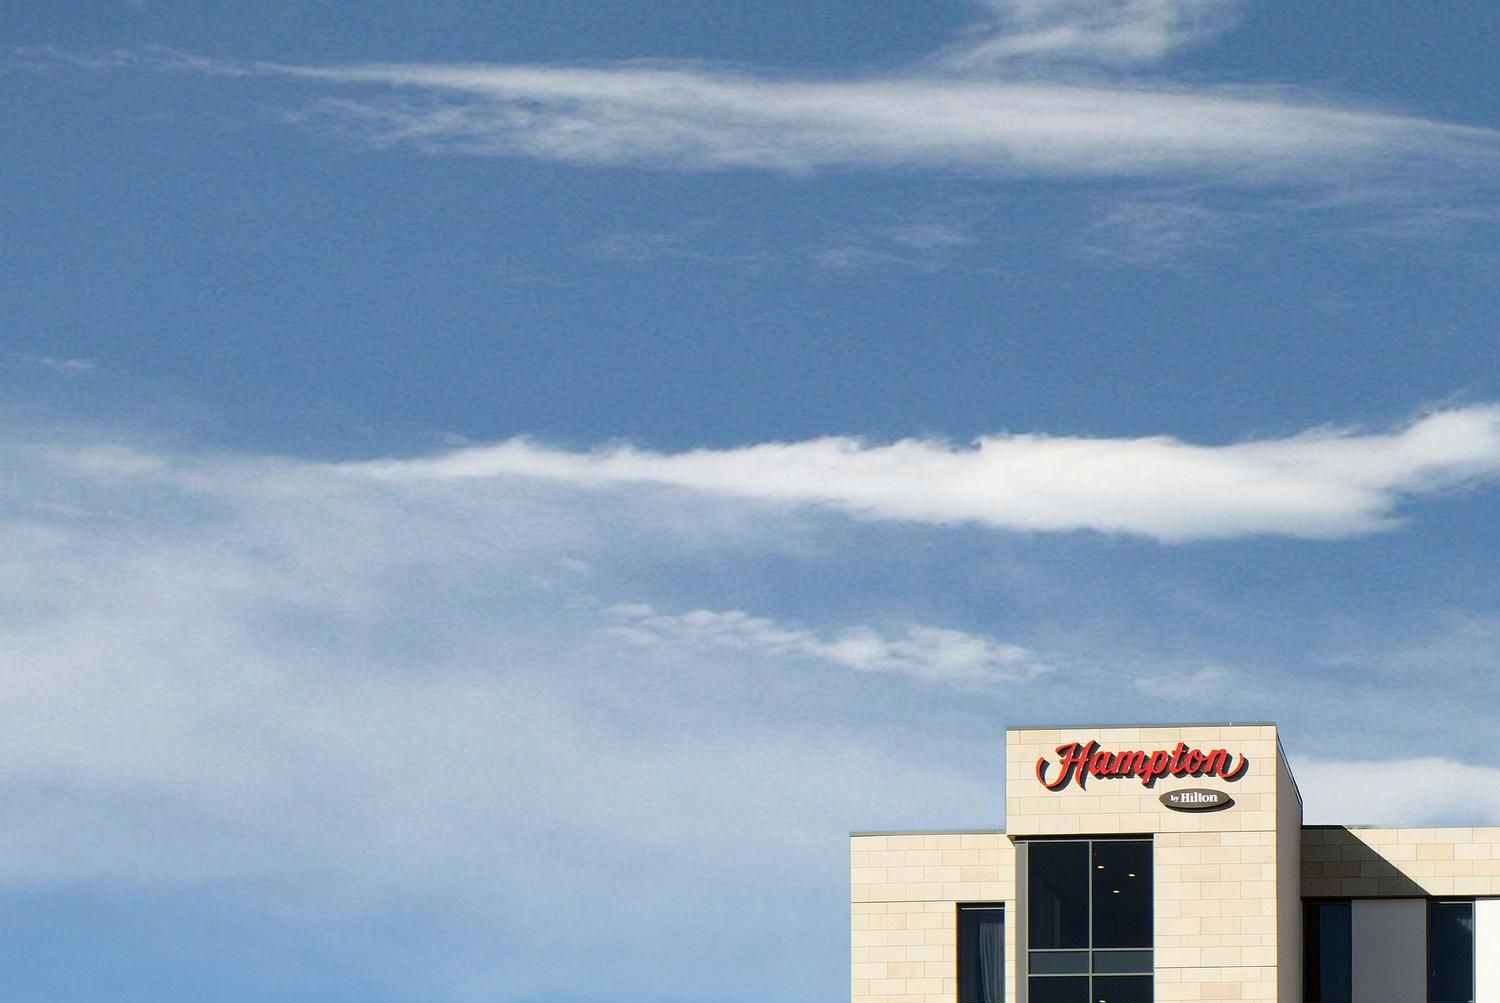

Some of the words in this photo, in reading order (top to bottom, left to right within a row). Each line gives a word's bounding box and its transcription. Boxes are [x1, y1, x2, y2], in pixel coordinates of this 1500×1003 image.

[1036, 740, 1246, 789] Hampton
[1170, 794, 1179, 803] by
[1180, 792, 1218, 803] Hilton
